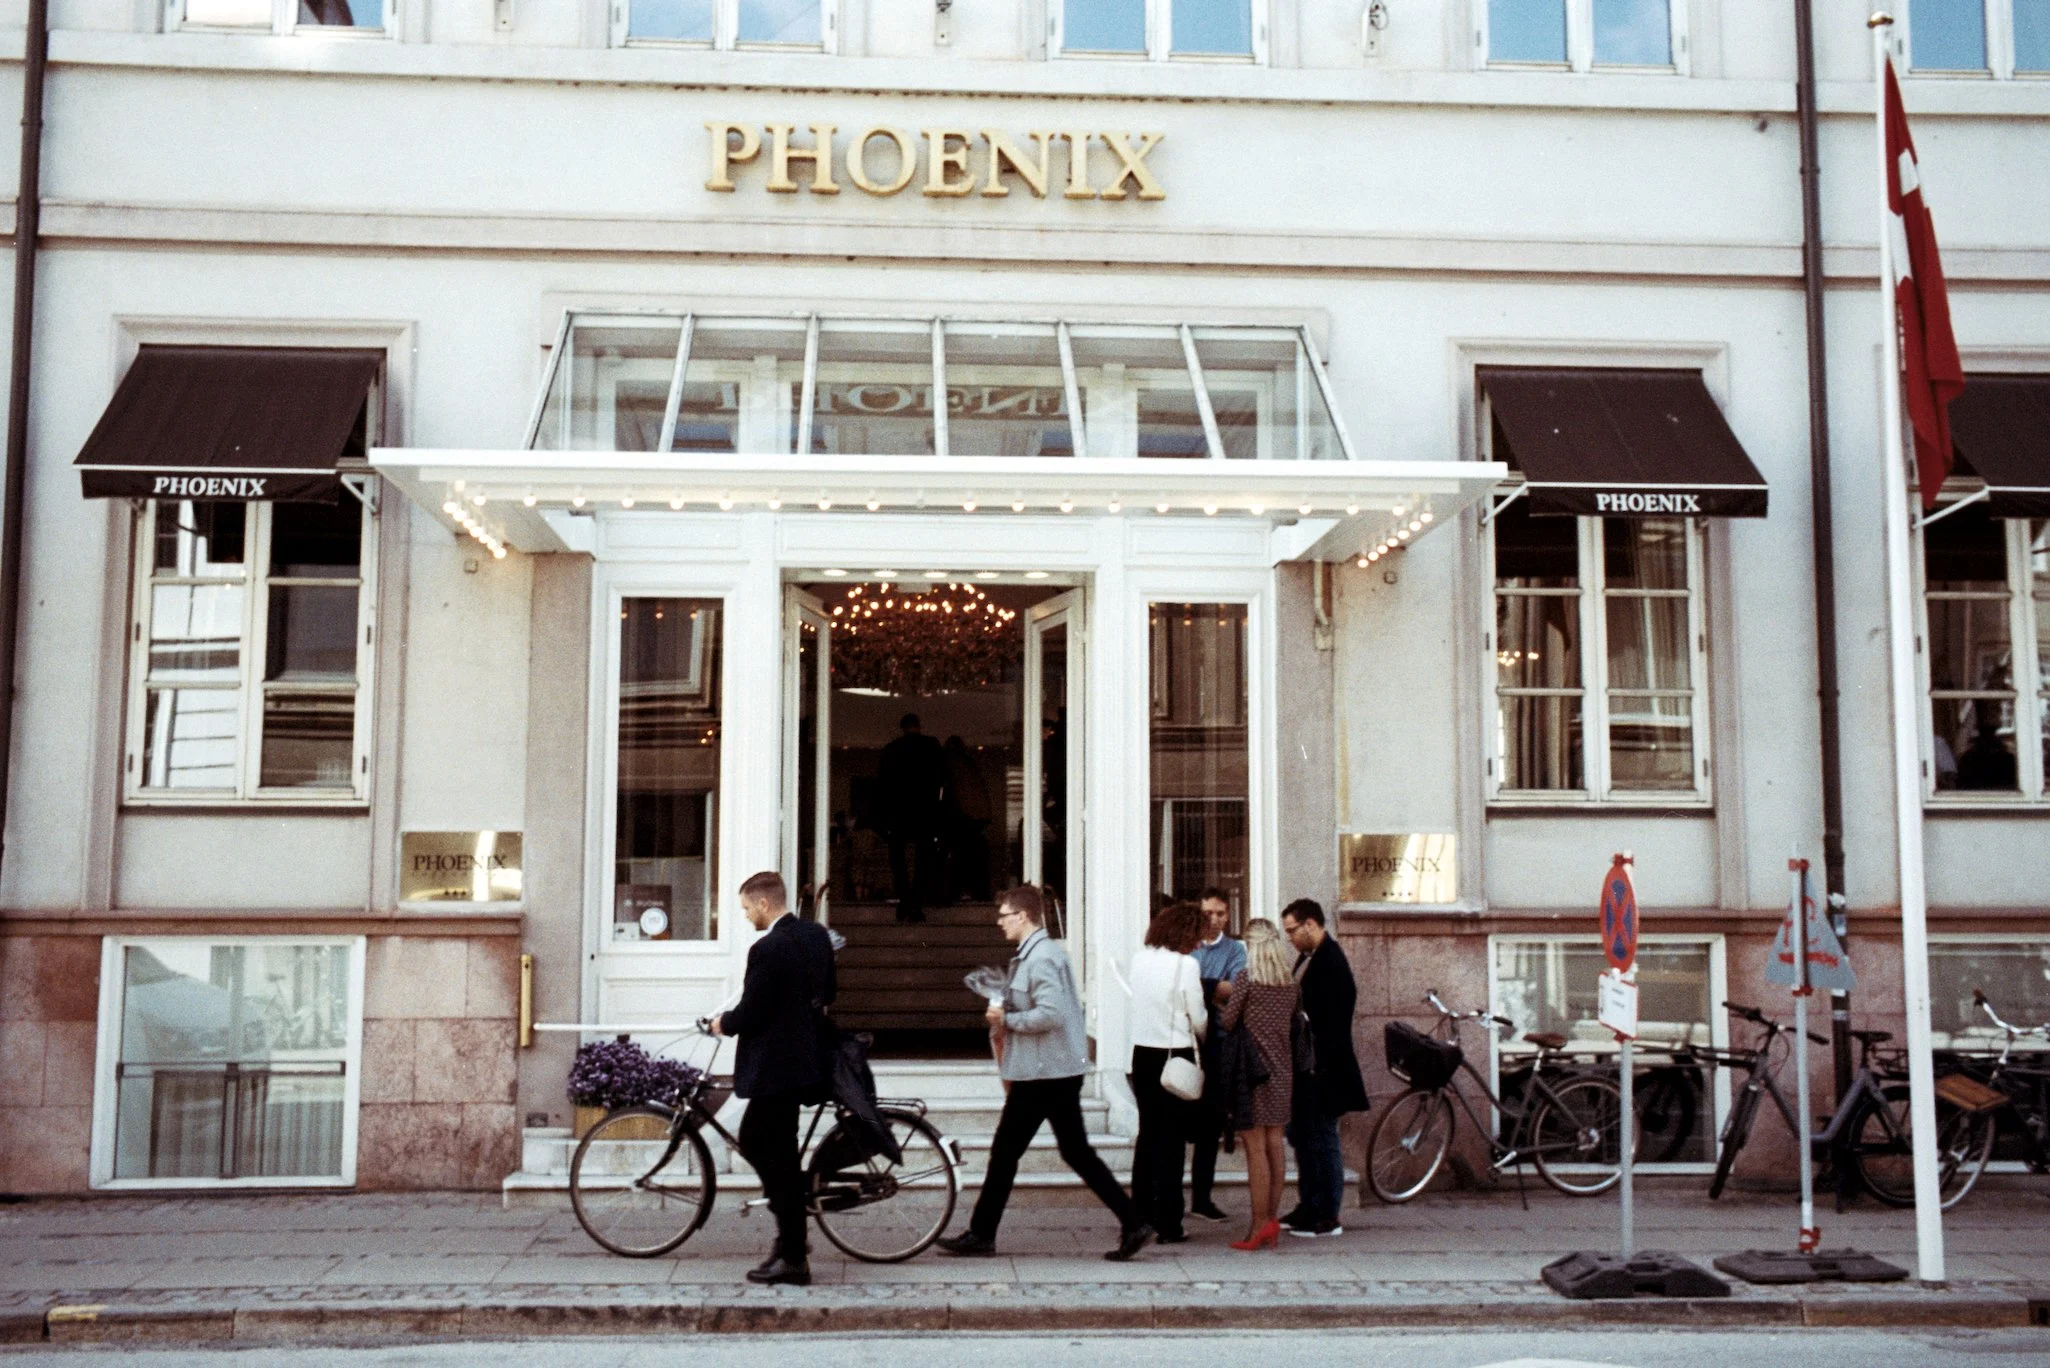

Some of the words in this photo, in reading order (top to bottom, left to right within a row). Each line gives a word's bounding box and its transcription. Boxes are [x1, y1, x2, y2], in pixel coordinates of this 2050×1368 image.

[704, 120, 1166, 201] PHOENIX
[153, 476, 267, 496] PHOENIX
[1595, 492, 1701, 512] PHOENIX
